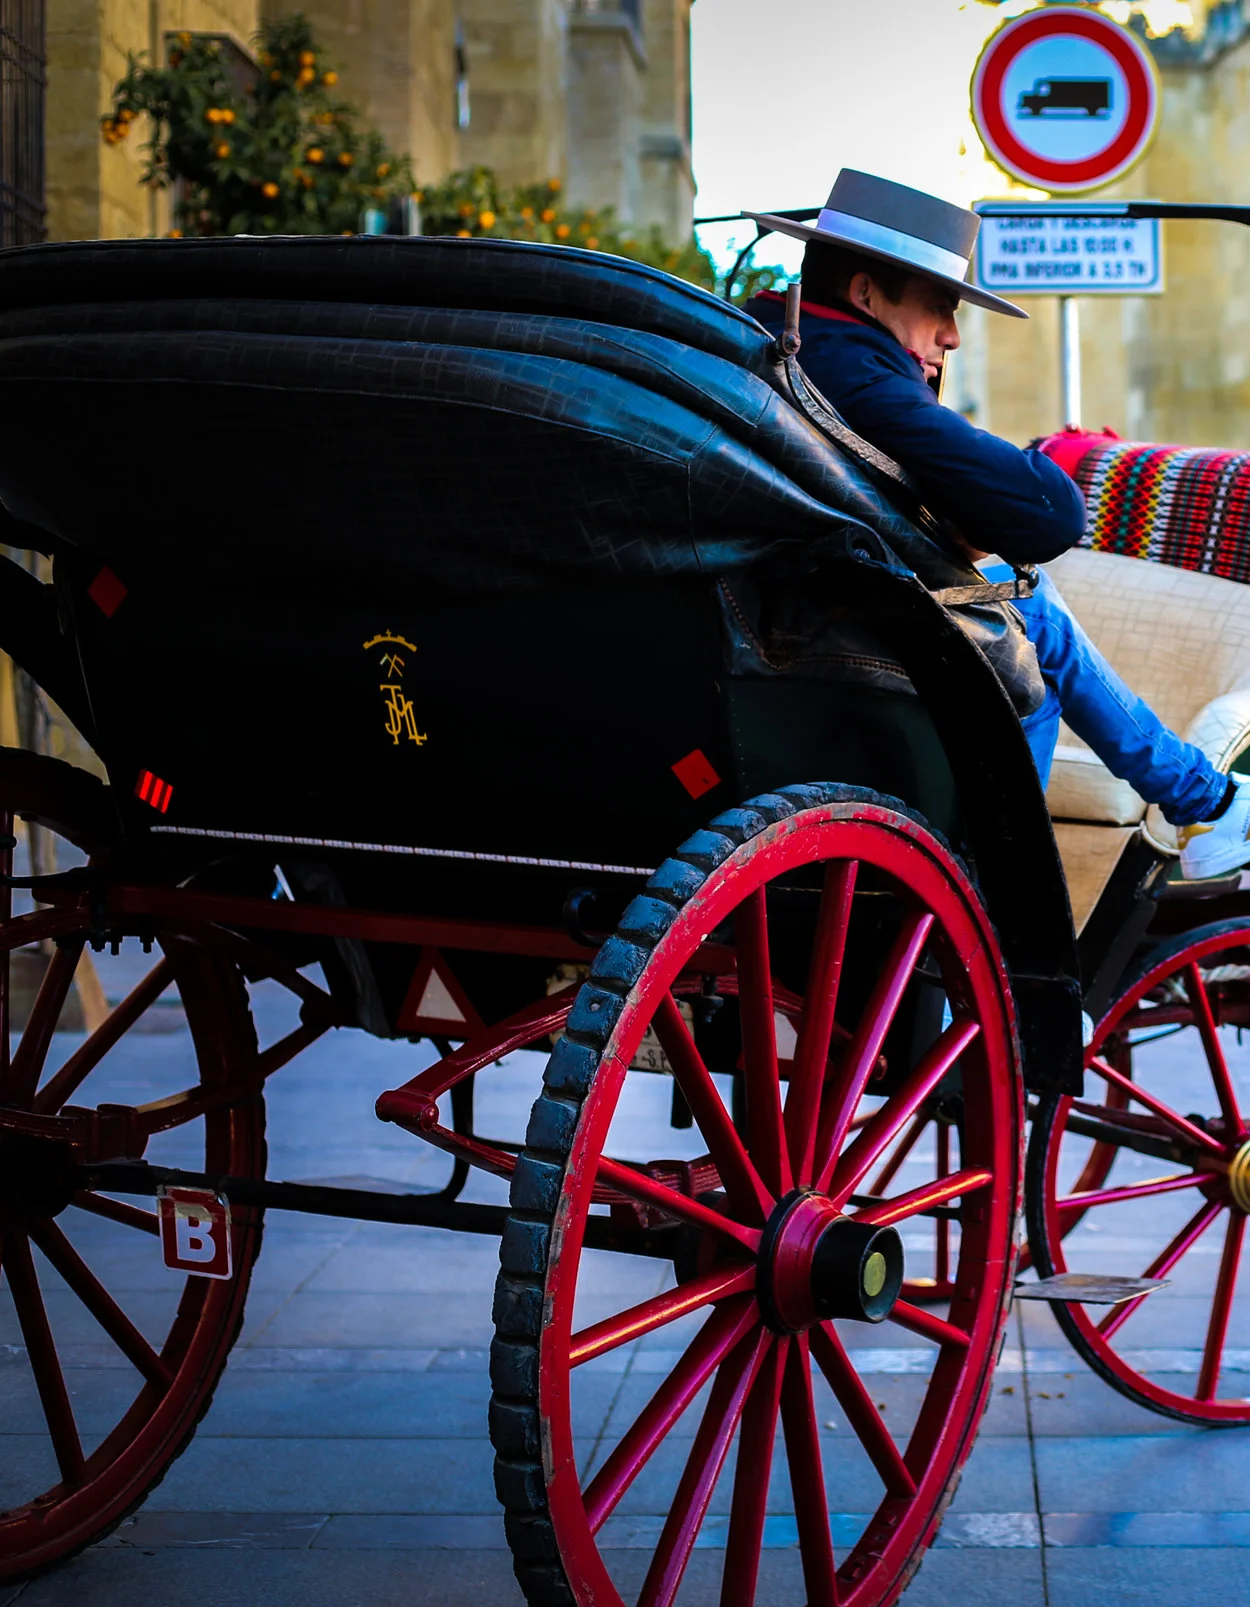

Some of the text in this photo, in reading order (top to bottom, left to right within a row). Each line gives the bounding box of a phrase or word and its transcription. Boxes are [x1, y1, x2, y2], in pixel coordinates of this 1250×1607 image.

[1001, 238, 1046, 254] HASTA
[1052, 238, 1079, 254] LAS
[1026, 262, 1081, 278] INFERIOR
[175, 1202, 217, 1263] B
